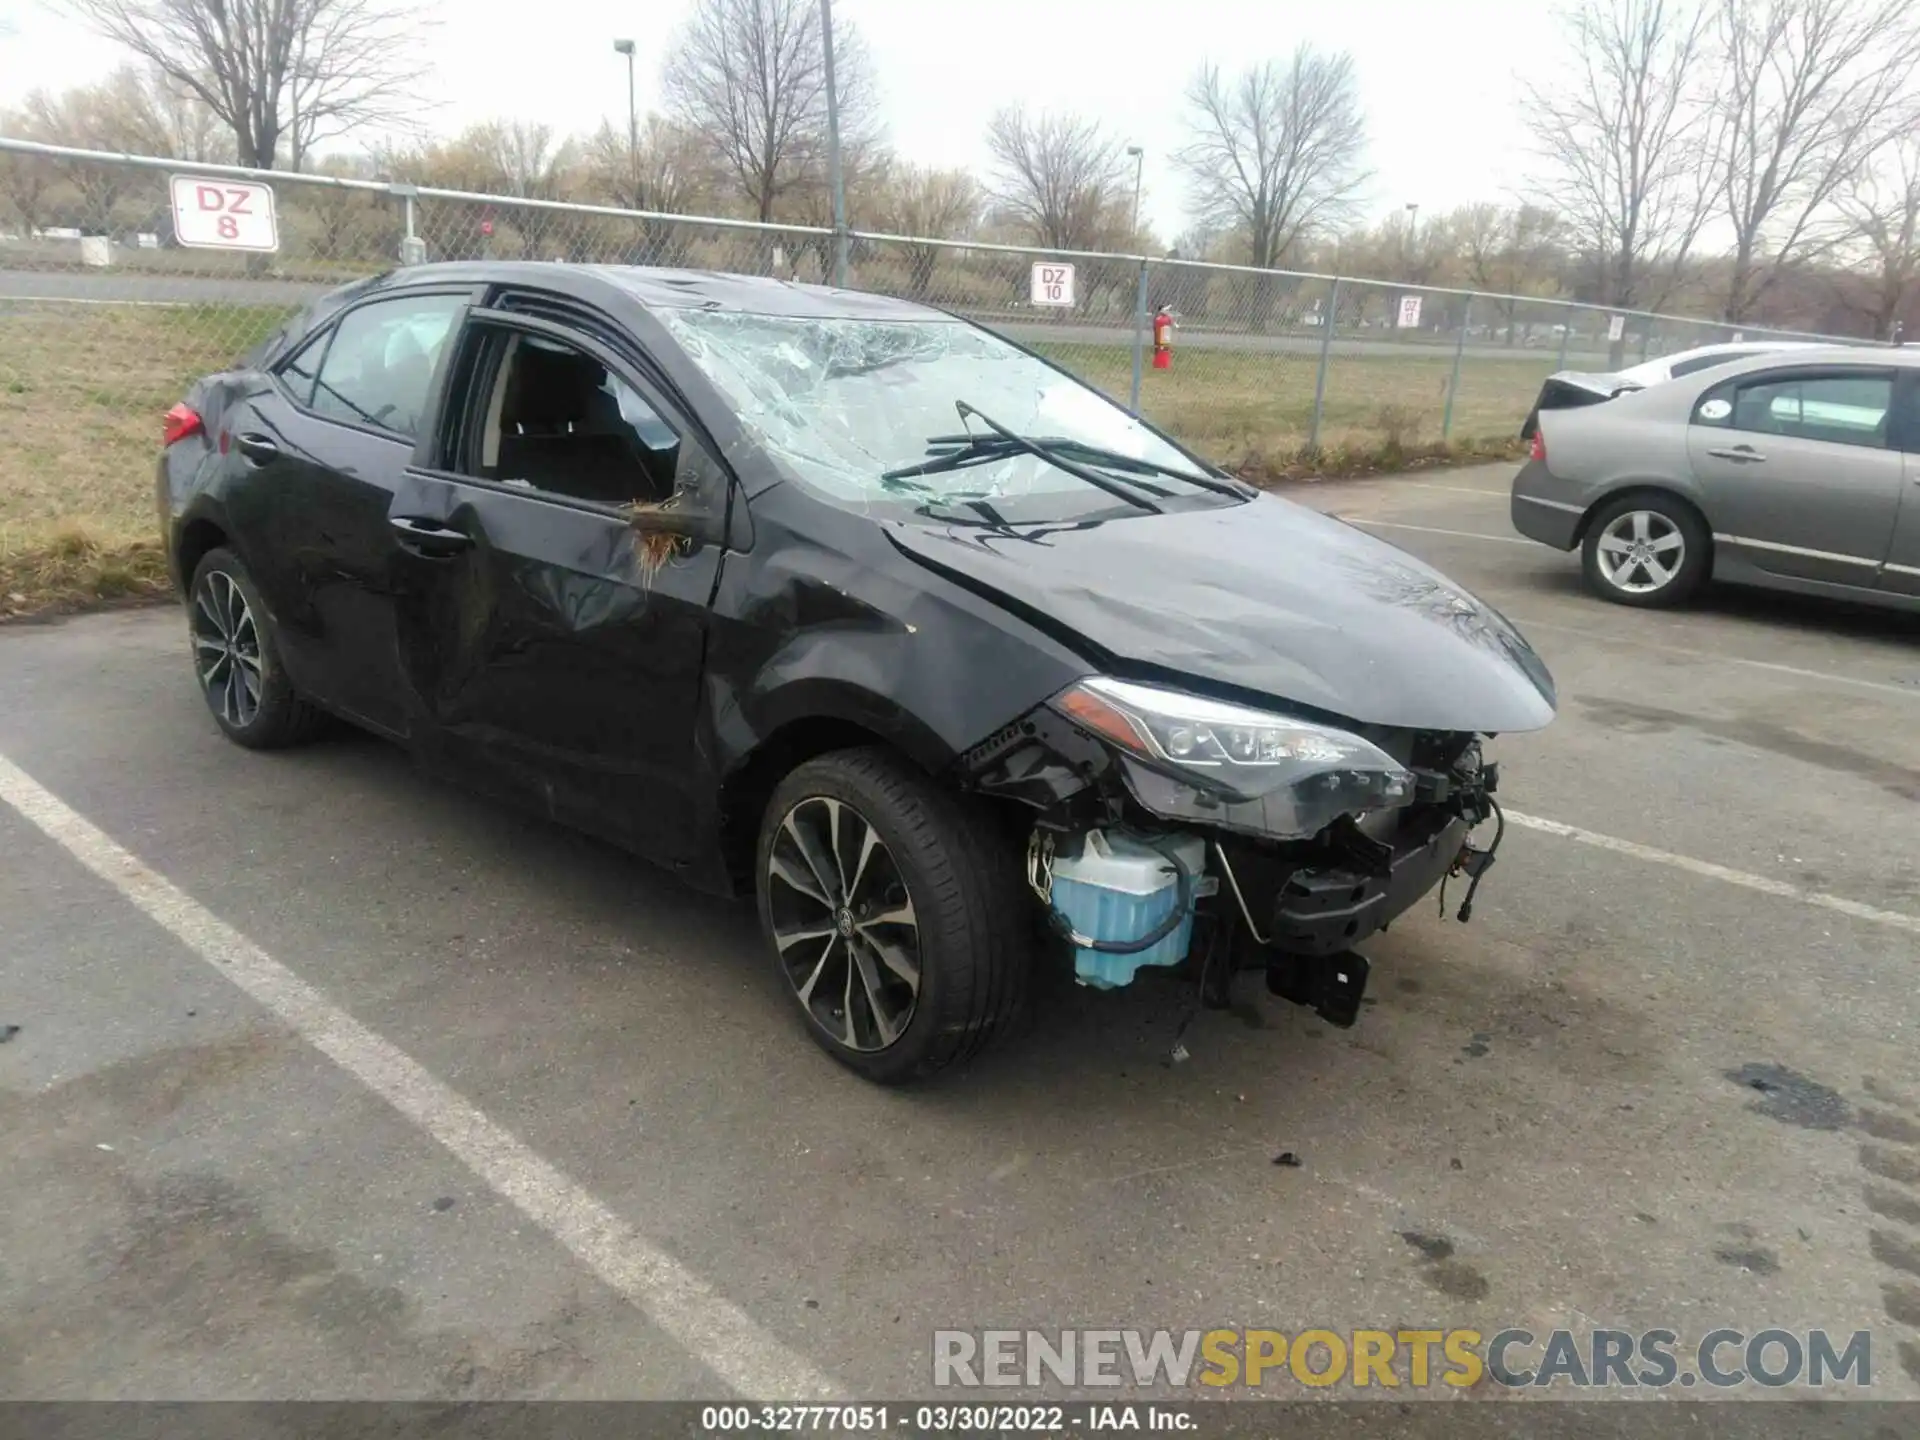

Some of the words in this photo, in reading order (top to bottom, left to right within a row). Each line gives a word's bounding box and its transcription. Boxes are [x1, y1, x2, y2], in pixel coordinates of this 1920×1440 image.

[196, 185, 253, 214] DZ
[218, 215, 239, 238] 8
[1042, 268, 1065, 284] DZ
[1045, 284, 1062, 300] 10
